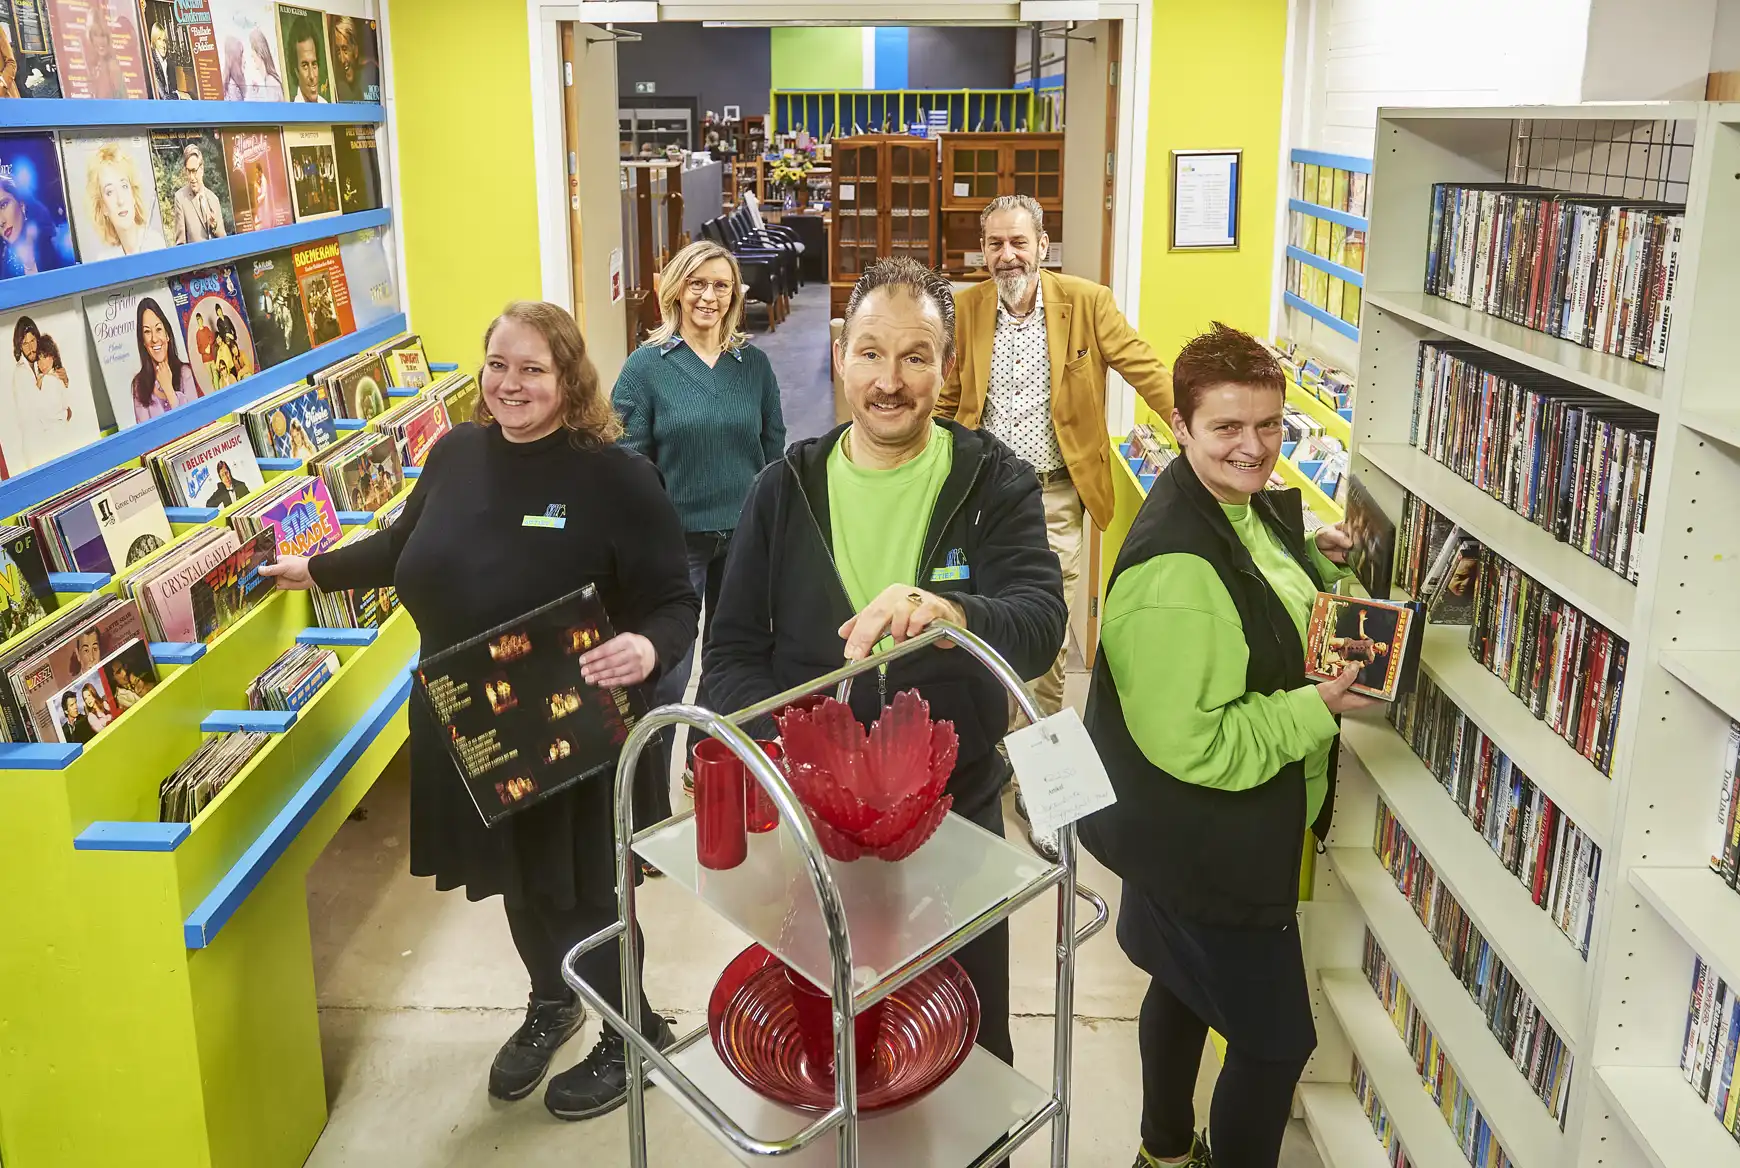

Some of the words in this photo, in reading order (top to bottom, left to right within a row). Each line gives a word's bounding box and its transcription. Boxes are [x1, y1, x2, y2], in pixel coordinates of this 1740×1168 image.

[280, 6, 291, 14] JULIO
[191, 26, 211, 36] Ballade
[294, 243, 340, 268] BOEMERANG
[1559, 237, 1568, 277] SALT
[1653, 244, 1664, 278] ROYAL
[190, 273, 220, 298] CATS
[1593, 258, 1603, 307] EDISON
[1665, 251, 1678, 302] STEALING
[1645, 283, 1660, 338] WEDDING
[1658, 305, 1671, 354] SINATRA
[181, 462, 187, 472] I
[186, 449, 212, 471] BELIEVE
[212, 445, 222, 457] IN
[221, 434, 242, 453] MUSIC
[1589, 469, 1597, 498] BORAT
[1597, 454, 1605, 487] ROWAN
[281, 501, 321, 542] STAR
[1592, 489, 1601, 533] ATKINSON
[15, 535, 32, 554] OF
[278, 510, 333, 556] PARADE
[160, 563, 206, 599] CRYSTAL
[931, 571, 955, 581] CTIEF
[1397, 610, 1407, 639] BERT
[1523, 609, 1534, 672] ALEXANDER
[26, 666, 52, 690] JAZZ
[1723, 769, 1733, 788] THE
[1717, 788, 1731, 825] CLIMB
[1698, 963, 1708, 981] THIS
[1693, 980, 1704, 1009] MEANS
[1691, 1007, 1700, 1025] WAR
[1708, 1001, 1722, 1045] DEADLIEST
[1704, 1045, 1714, 1072] CATCH
